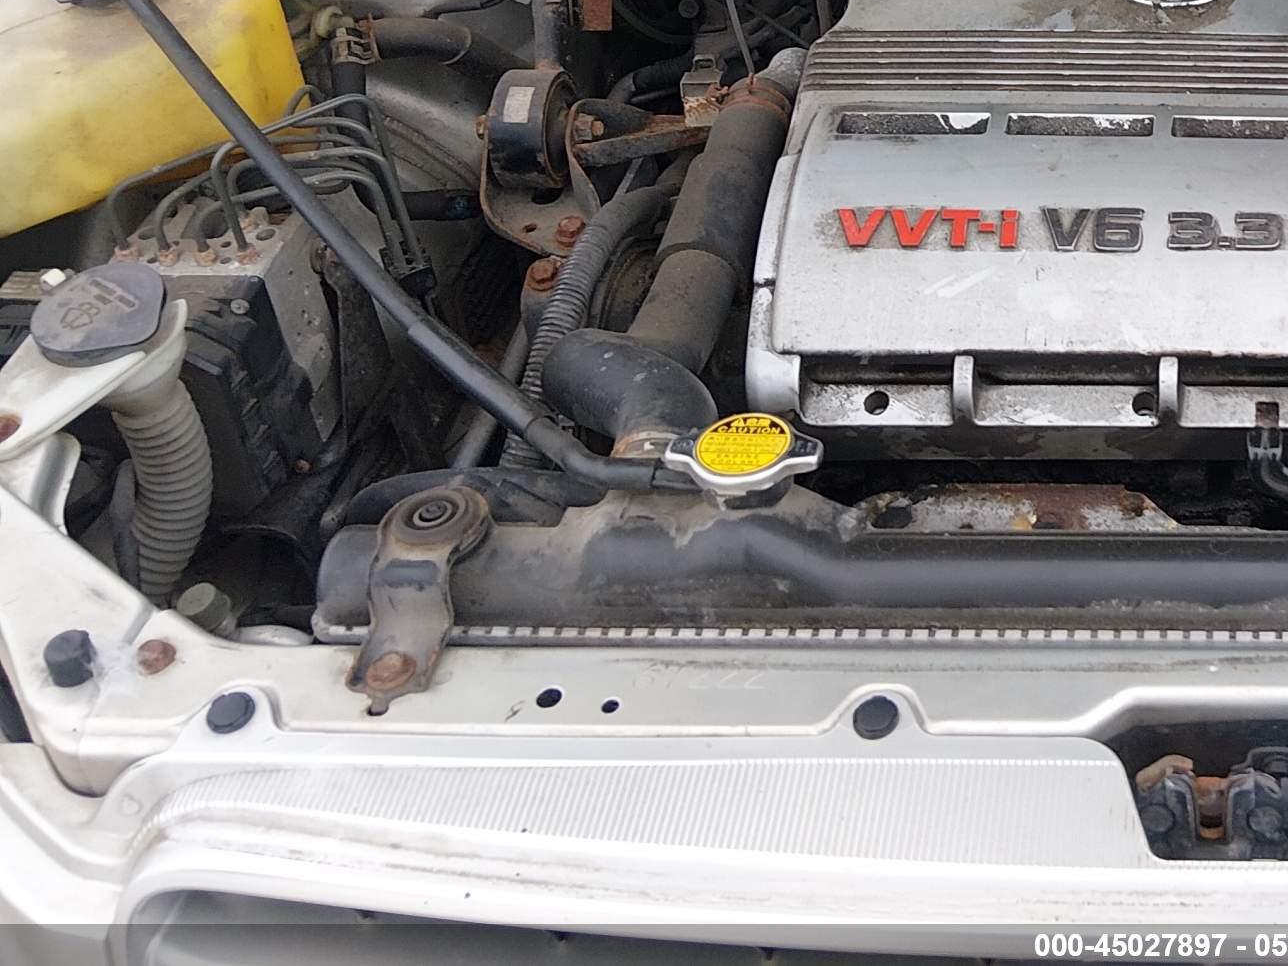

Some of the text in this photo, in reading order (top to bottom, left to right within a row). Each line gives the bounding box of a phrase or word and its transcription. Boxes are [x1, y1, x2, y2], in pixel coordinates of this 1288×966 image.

[1042, 207, 1144, 252] V6
[1167, 211, 1282, 252] 3.3
[717, 425, 781, 435] CAUTION
